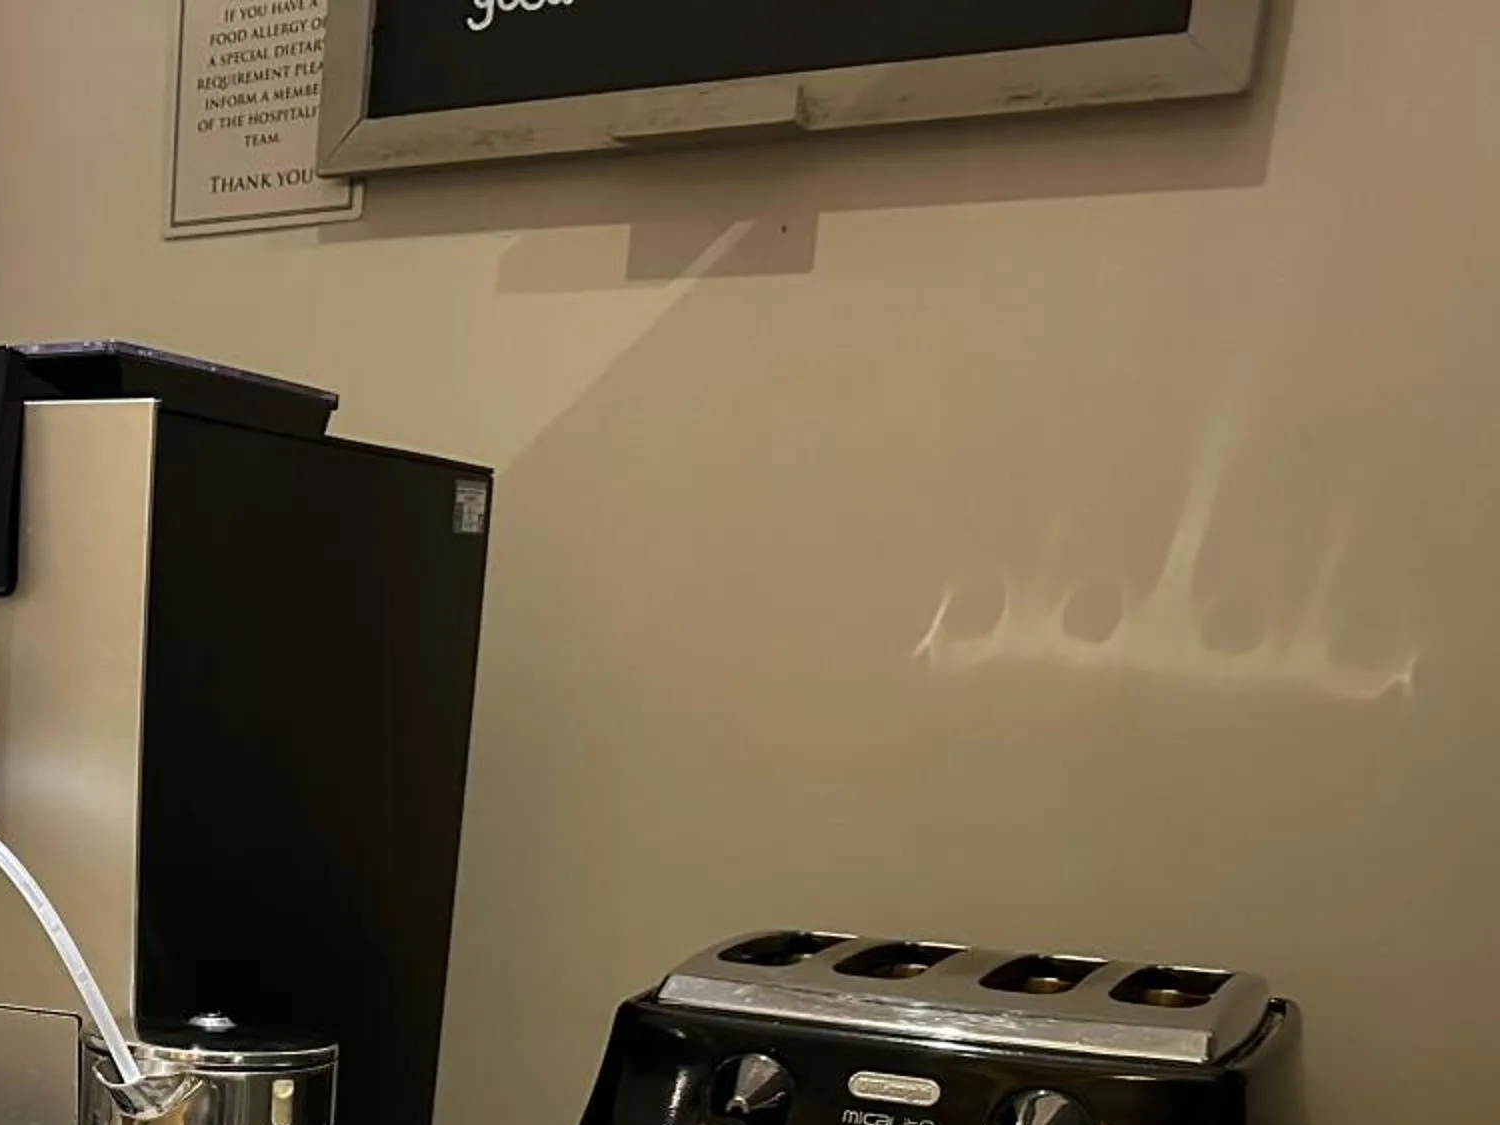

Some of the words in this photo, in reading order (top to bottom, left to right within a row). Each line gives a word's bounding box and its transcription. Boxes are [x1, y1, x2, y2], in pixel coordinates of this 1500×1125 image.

[224, 8, 235, 23] IF
[239, 4, 268, 21] YOU
[209, 28, 248, 47] FOOD
[251, 19, 309, 40] ALLERGY
[208, 55, 217, 67] A
[219, 47, 270, 66] SPECIAL
[273, 39, 325, 59] DIETAR
[196, 65, 291, 91] REQUIREMENT
[294, 60, 324, 77] PLEA
[204, 91, 258, 110] INFORM
[260, 91, 270, 103] A
[272, 82, 320, 100] MEMBE
[197, 118, 215, 133] OF
[219, 114, 246, 129] THE
[247, 105, 320, 126] HOSPITALI
[209, 171, 273, 194] THANK
[277, 167, 315, 187] YOU
